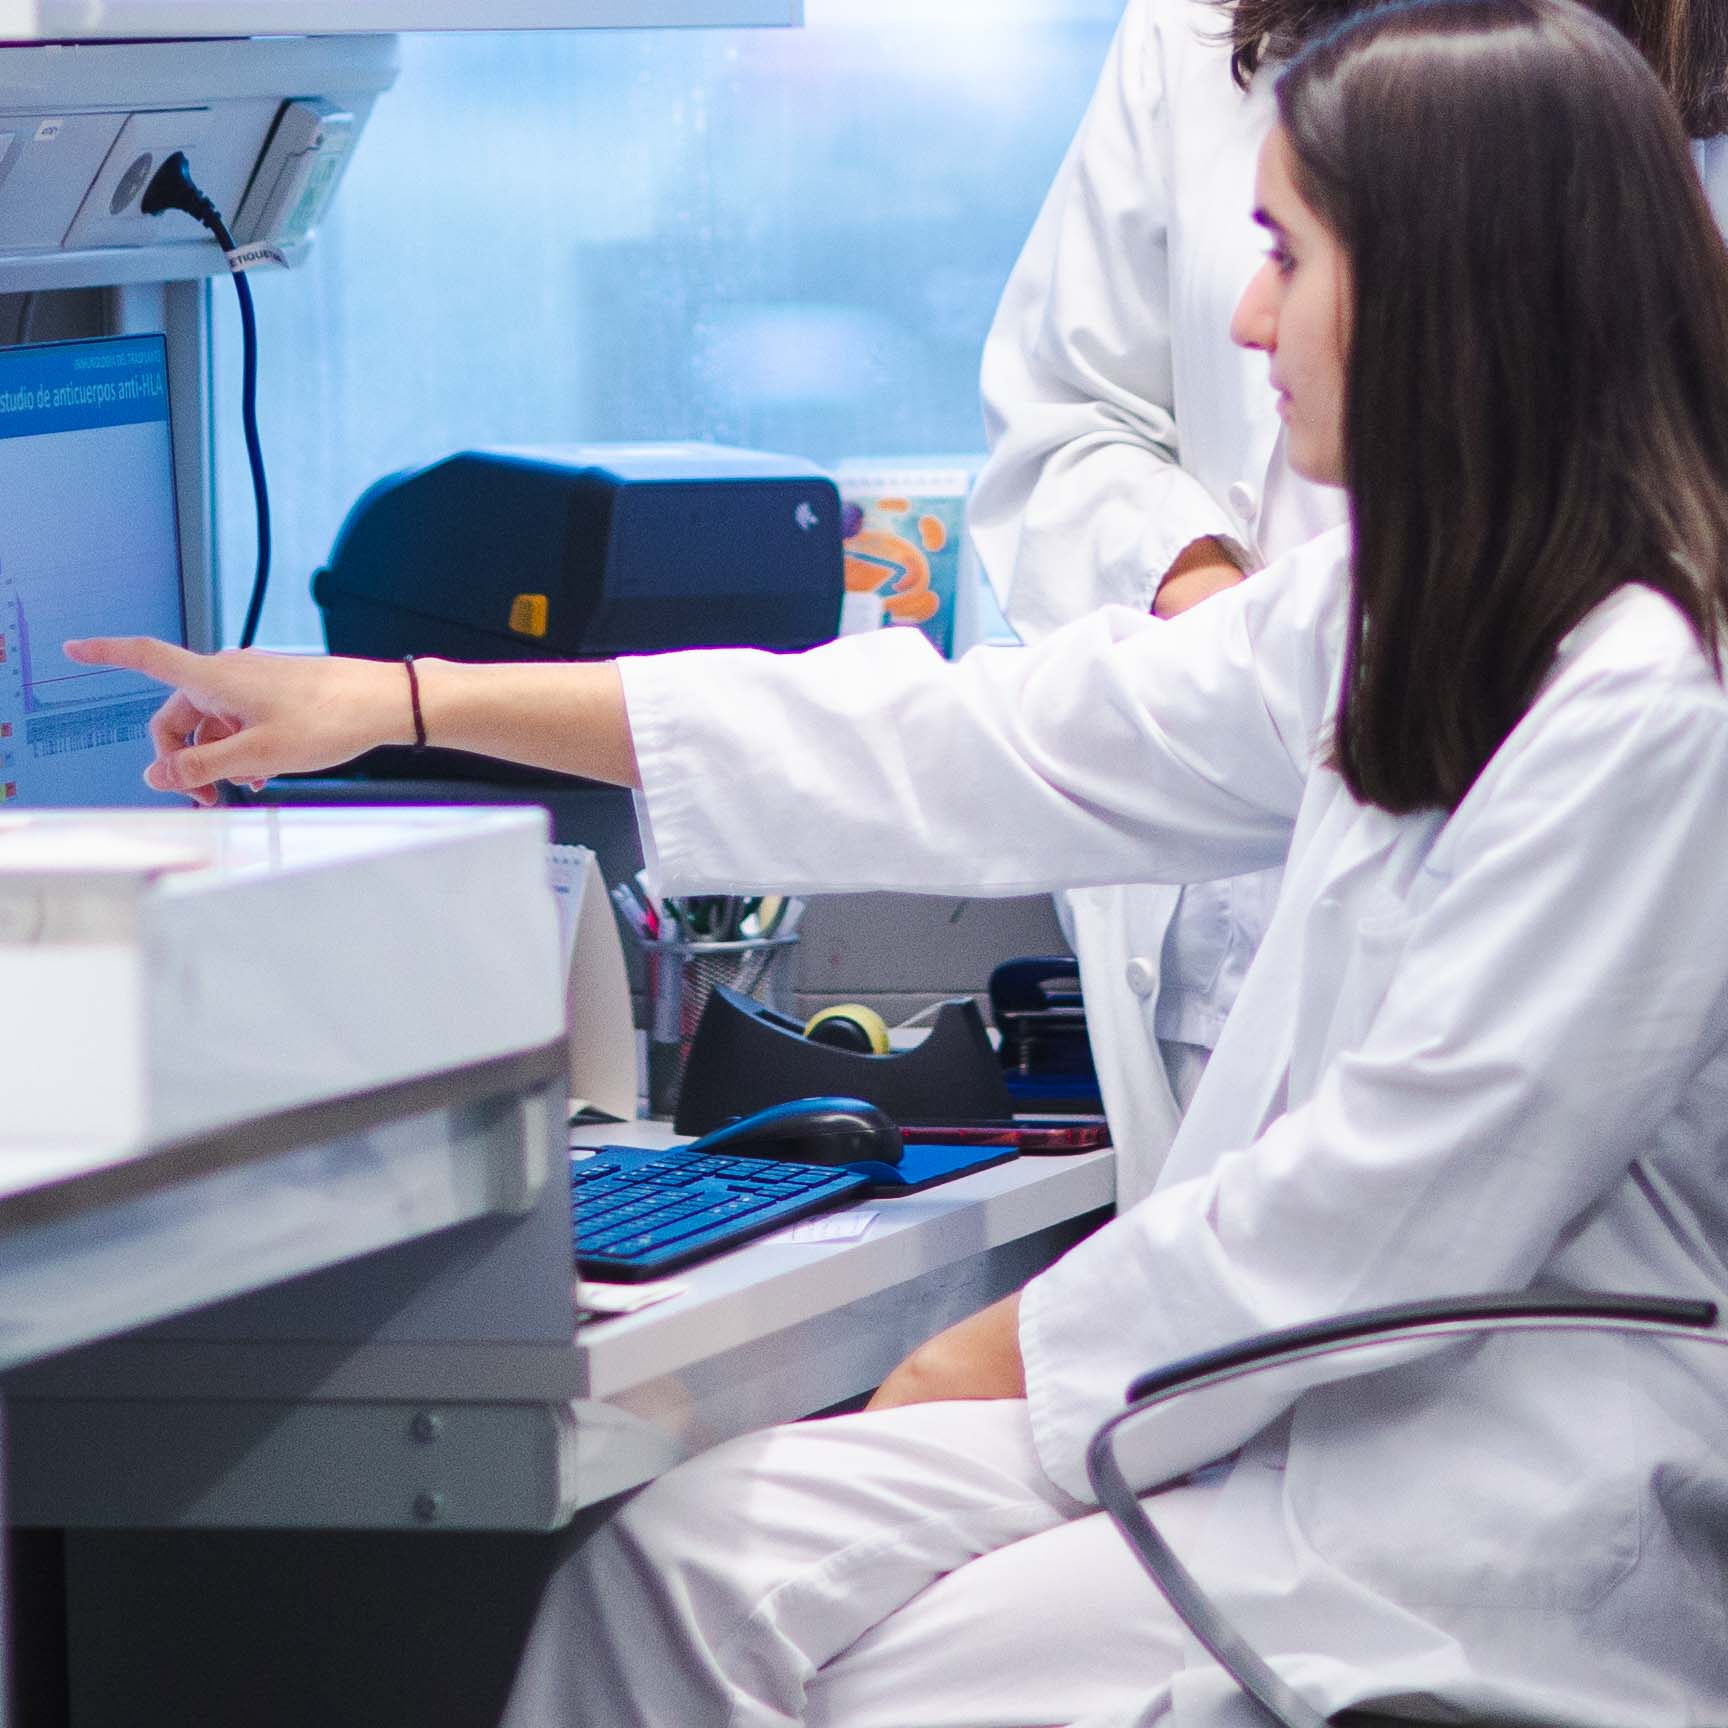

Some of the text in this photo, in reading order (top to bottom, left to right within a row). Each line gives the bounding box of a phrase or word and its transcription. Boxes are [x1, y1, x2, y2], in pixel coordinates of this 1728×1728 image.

[36, 384, 51, 407] de
[53, 379, 117, 407] anticuerpos
[118, 373, 163, 399] anti-HLA
